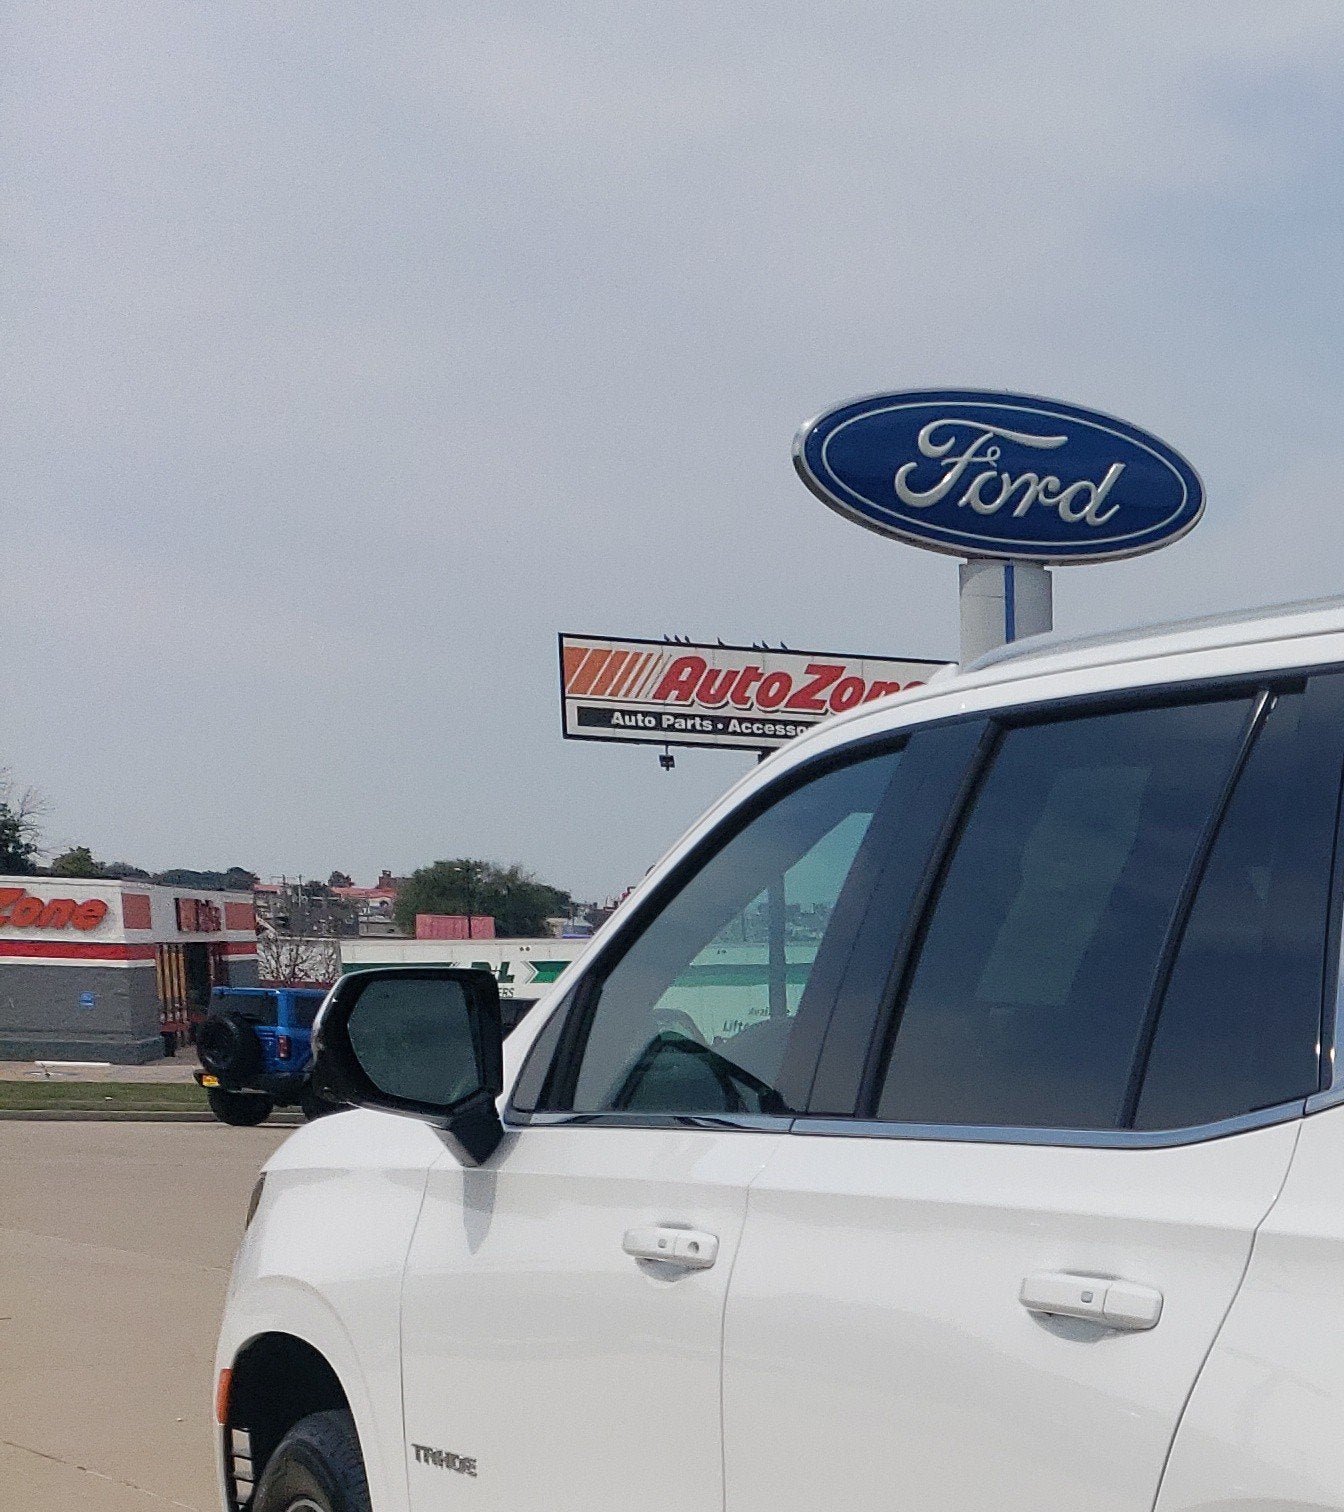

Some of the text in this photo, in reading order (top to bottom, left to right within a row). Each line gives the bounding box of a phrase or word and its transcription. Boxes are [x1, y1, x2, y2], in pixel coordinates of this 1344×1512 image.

[895, 419, 1126, 526] Ford
[651, 656, 928, 712] AutoZon
[611, 711, 656, 727] Auto
[661, 714, 713, 731] Parts
[411, 1443, 477, 1477] TAHOE
